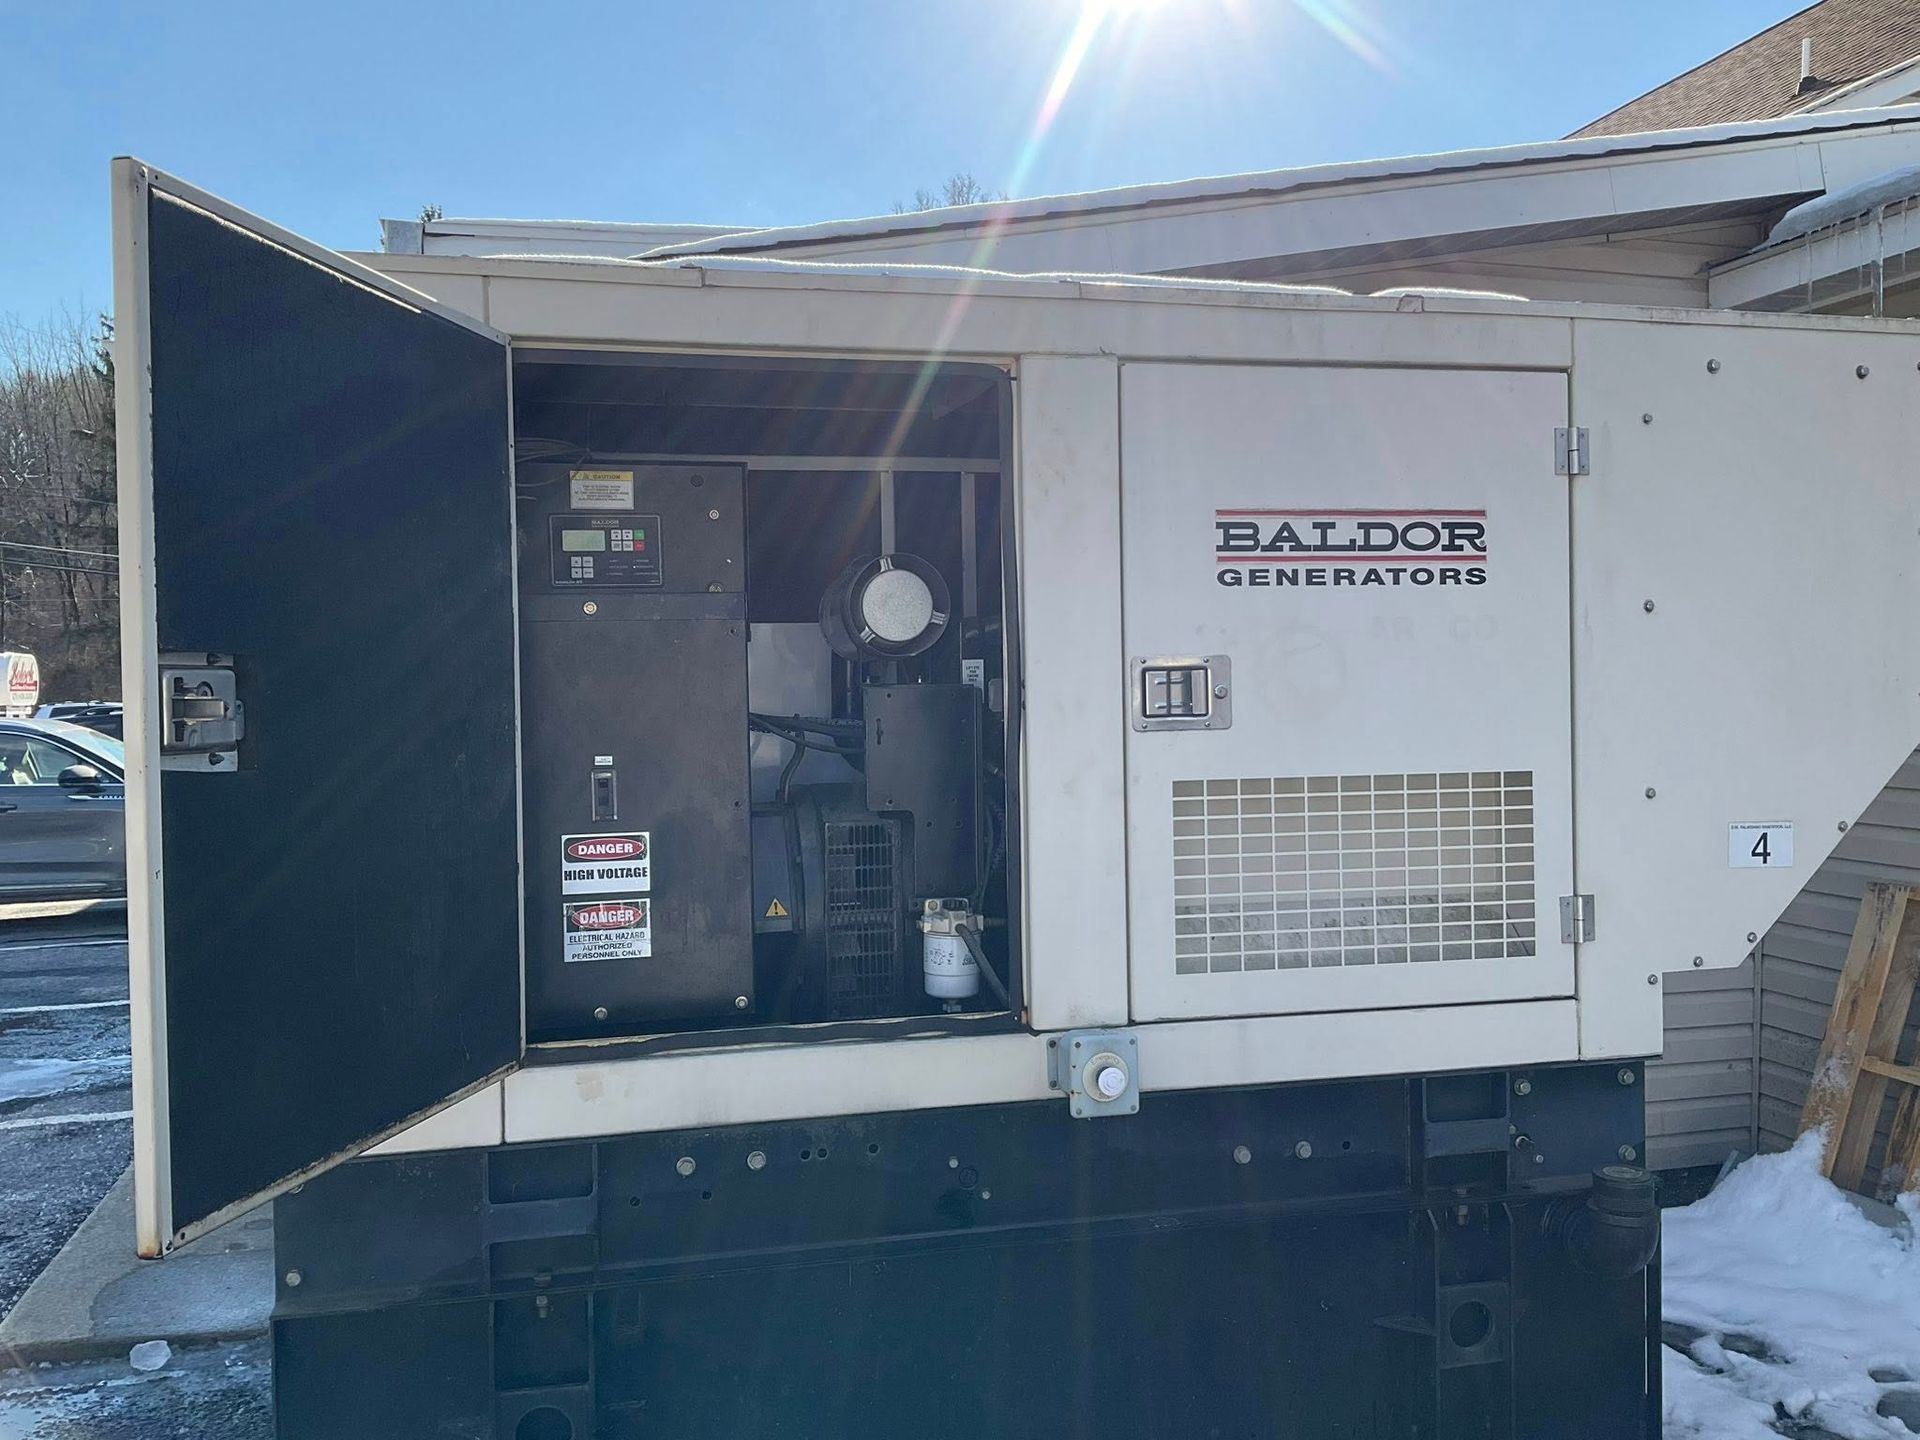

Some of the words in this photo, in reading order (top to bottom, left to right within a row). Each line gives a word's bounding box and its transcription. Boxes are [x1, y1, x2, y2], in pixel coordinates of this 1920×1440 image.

[1215, 521, 1487, 552] BALDOR
[1217, 567, 1487, 586] GENERATORS
[578, 844, 633, 855] DANGER
[1751, 832, 1771, 864] 4
[564, 869, 594, 881] HIGH
[597, 867, 648, 879] VOLTAGE
[580, 910, 633, 924] DANGER
[569, 932, 614, 943] ELECTRICAL
[615, 930, 645, 941] HAZARD
[583, 942, 632, 951] AUTHORIZED
[572, 951, 620, 960] PERSONNEL
[622, 949, 642, 957] ONLY
